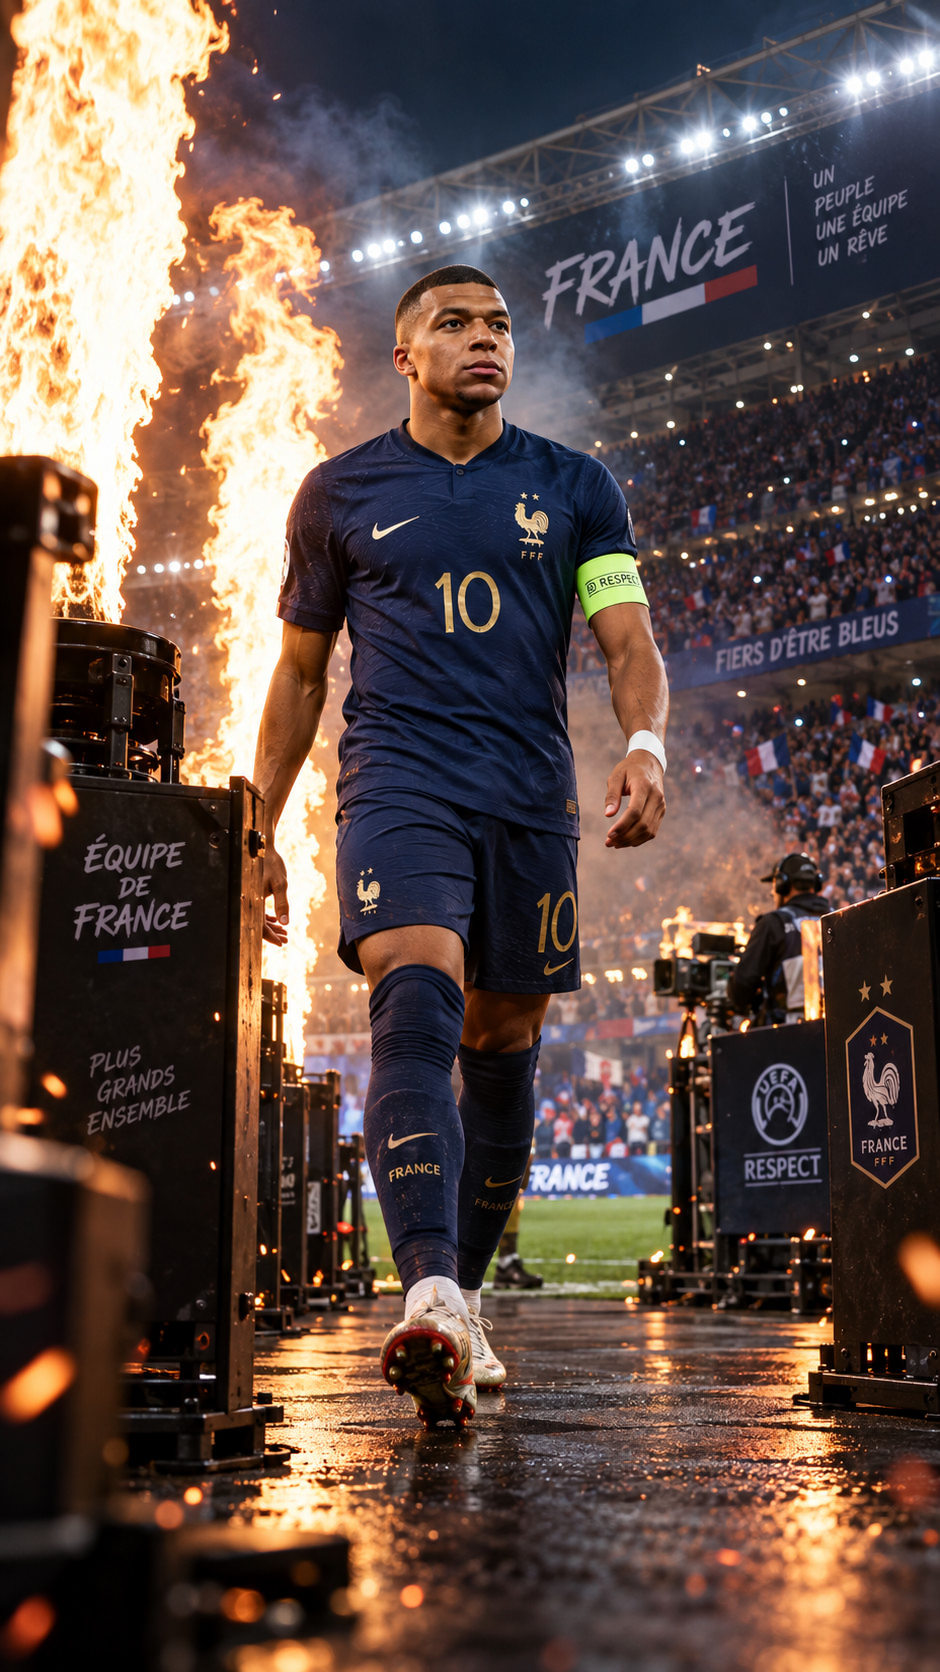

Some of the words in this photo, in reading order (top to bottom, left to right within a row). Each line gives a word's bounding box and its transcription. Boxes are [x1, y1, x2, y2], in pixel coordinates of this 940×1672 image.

[813, 165, 835, 189] UN
[814, 176, 876, 217] PEUPLE
[816, 217, 846, 241] UNE
[852, 189, 909, 224] ÉQUIPE
[542, 201, 756, 331] FRANCE
[817, 248, 839, 267] UN
[847, 224, 888, 257] RÊVE
[520, 550, 544, 561] FFF
[434, 570, 501, 634] 10
[715, 641, 765, 675] FIERS
[769, 625, 832, 662] D'ÊTRE
[838, 610, 899, 647] BLEUS
[83, 833, 187, 875] ÉQUIPE
[118, 875, 152, 900] DE
[73, 898, 193, 942] FRANCE
[536, 890, 578, 954] 10
[89, 1045, 142, 1079] PLUS
[758, 1070, 799, 1095] UEFA
[96, 1064, 176, 1105] GRANDS
[86, 1089, 192, 1137] ENSEMBLE
[860, 1135, 908, 1155] FRANCE
[874, 1156, 895, 1168] FFF
[388, 1162, 441, 1183] FRANCE
[744, 1154, 821, 1181] RESPECT
